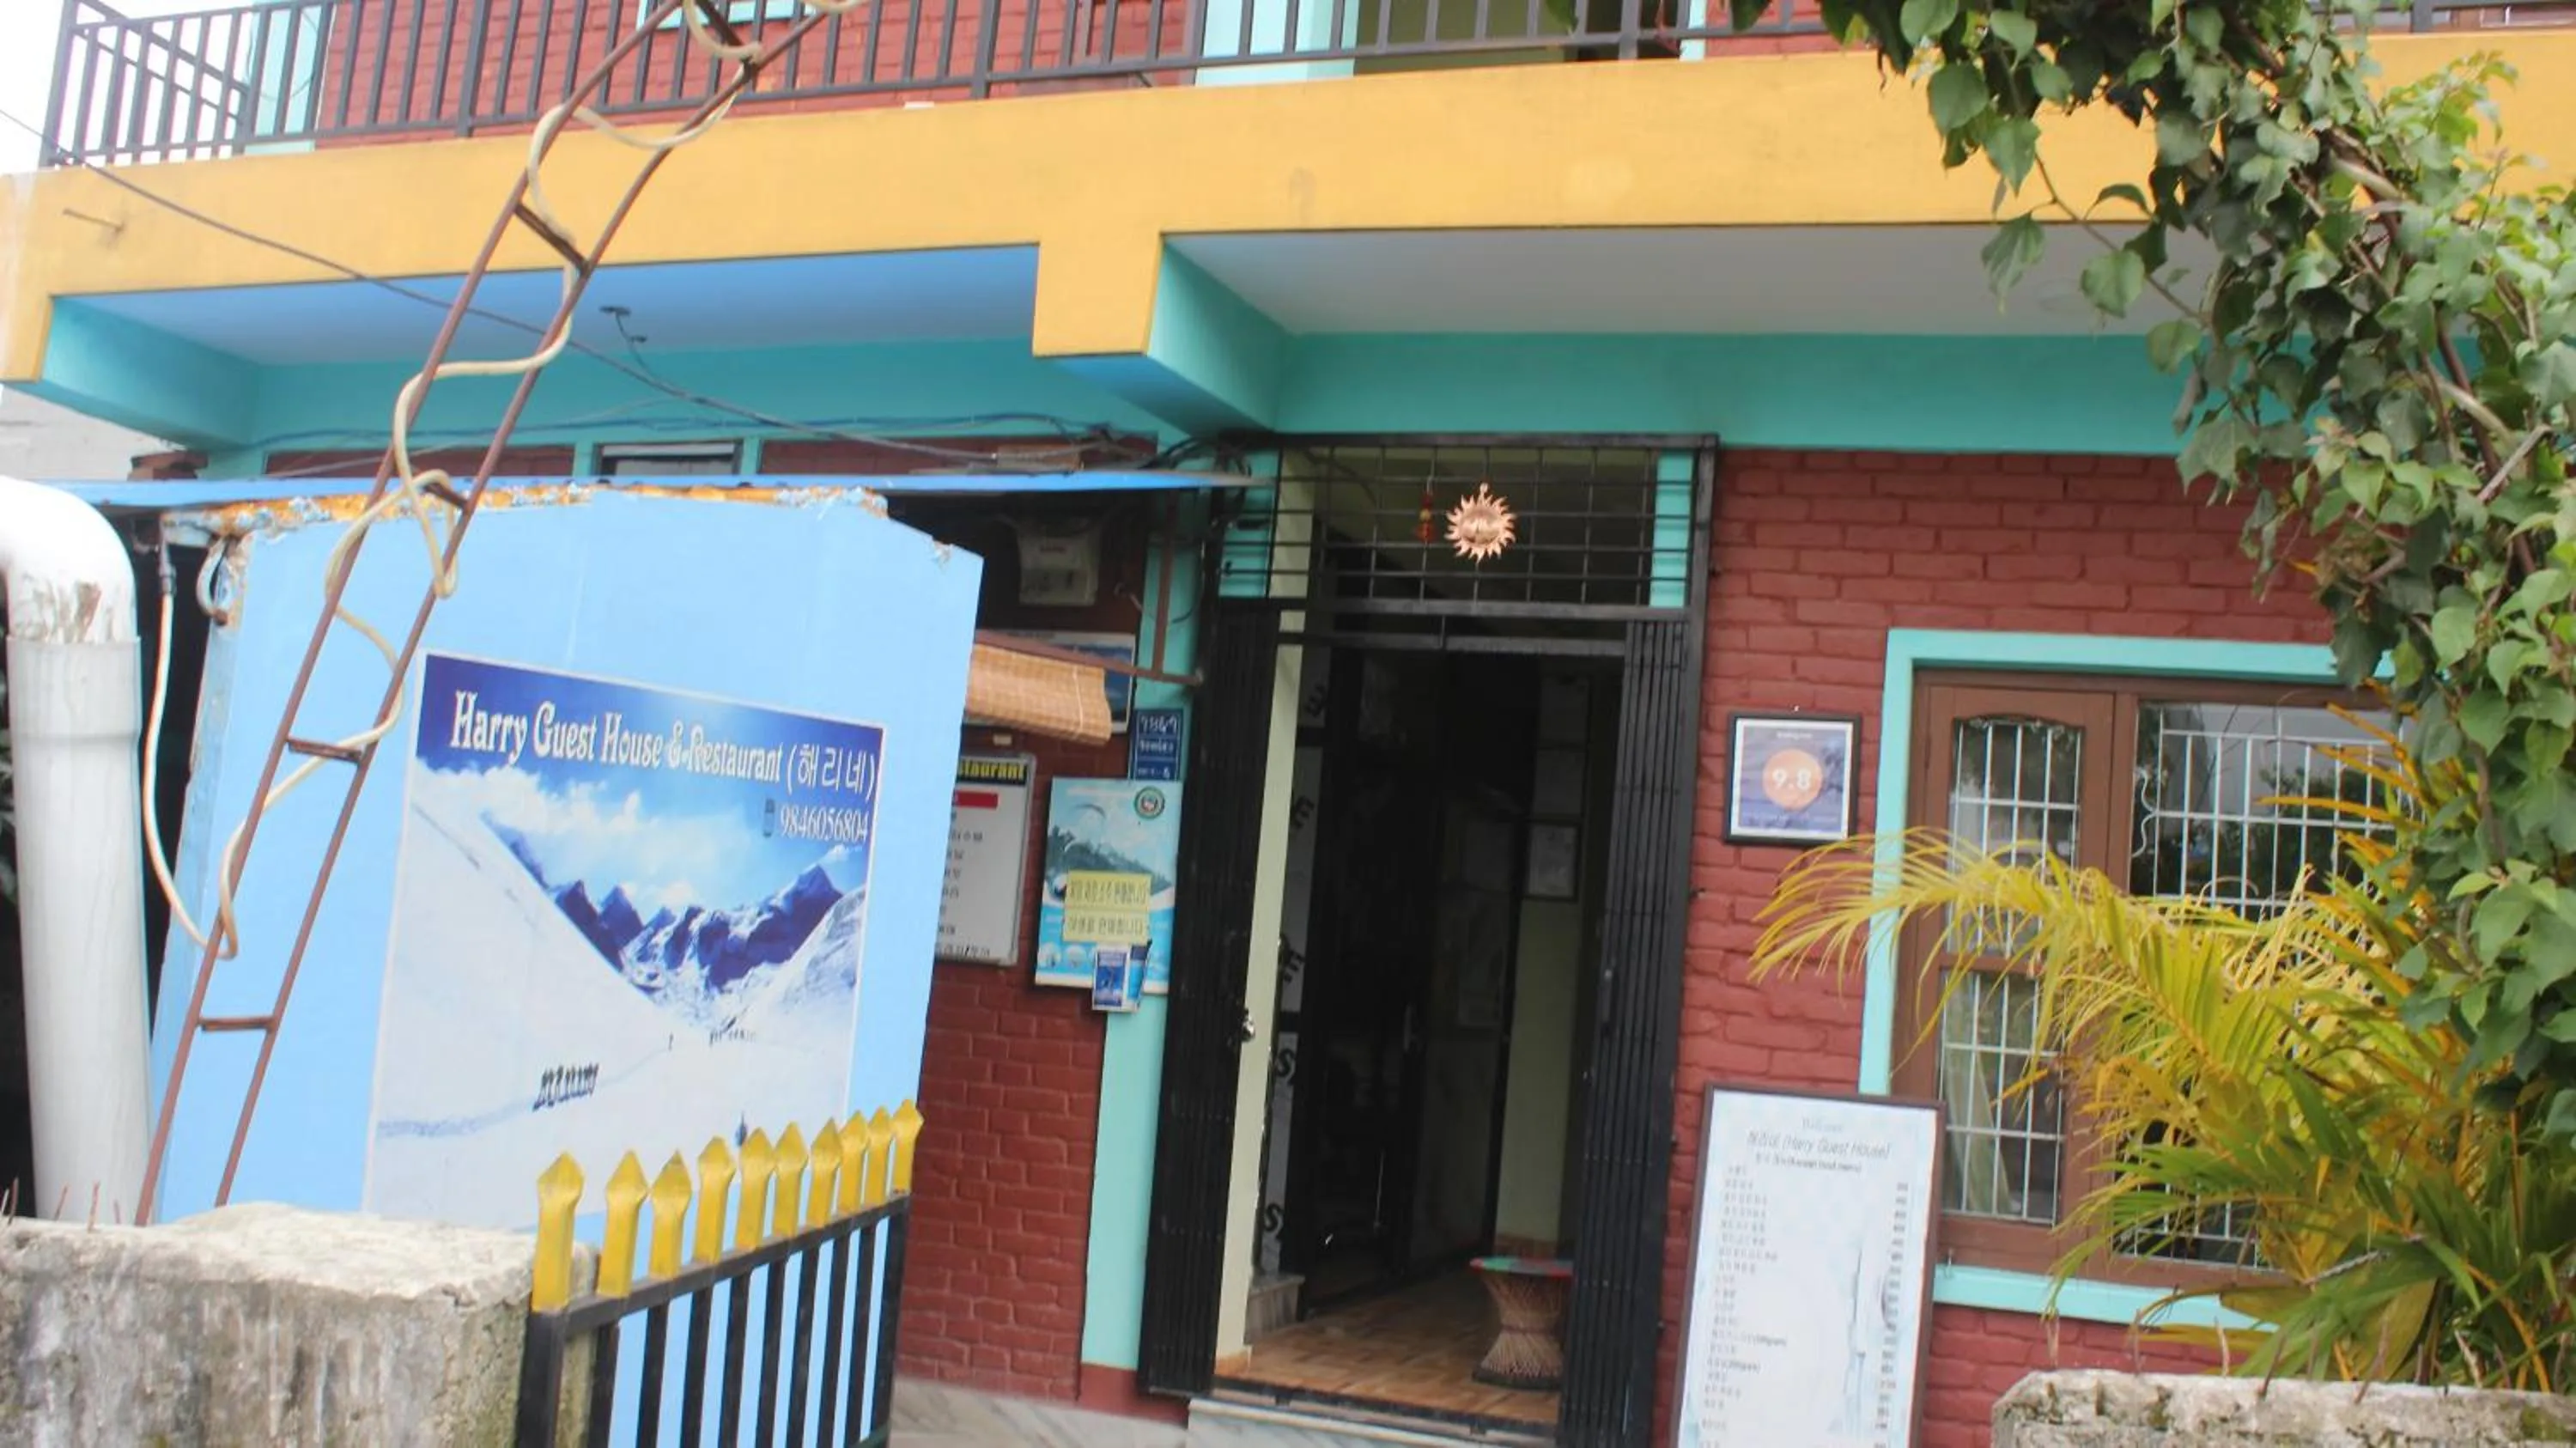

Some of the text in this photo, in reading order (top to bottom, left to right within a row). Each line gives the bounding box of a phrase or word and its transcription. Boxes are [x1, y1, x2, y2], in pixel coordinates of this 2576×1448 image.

[449, 689, 528, 764] Harry
[533, 701, 598, 761] Guest
[601, 711, 663, 769] House
[684, 724, 783, 782] Restaurant
[781, 805, 870, 843] 9846056804
